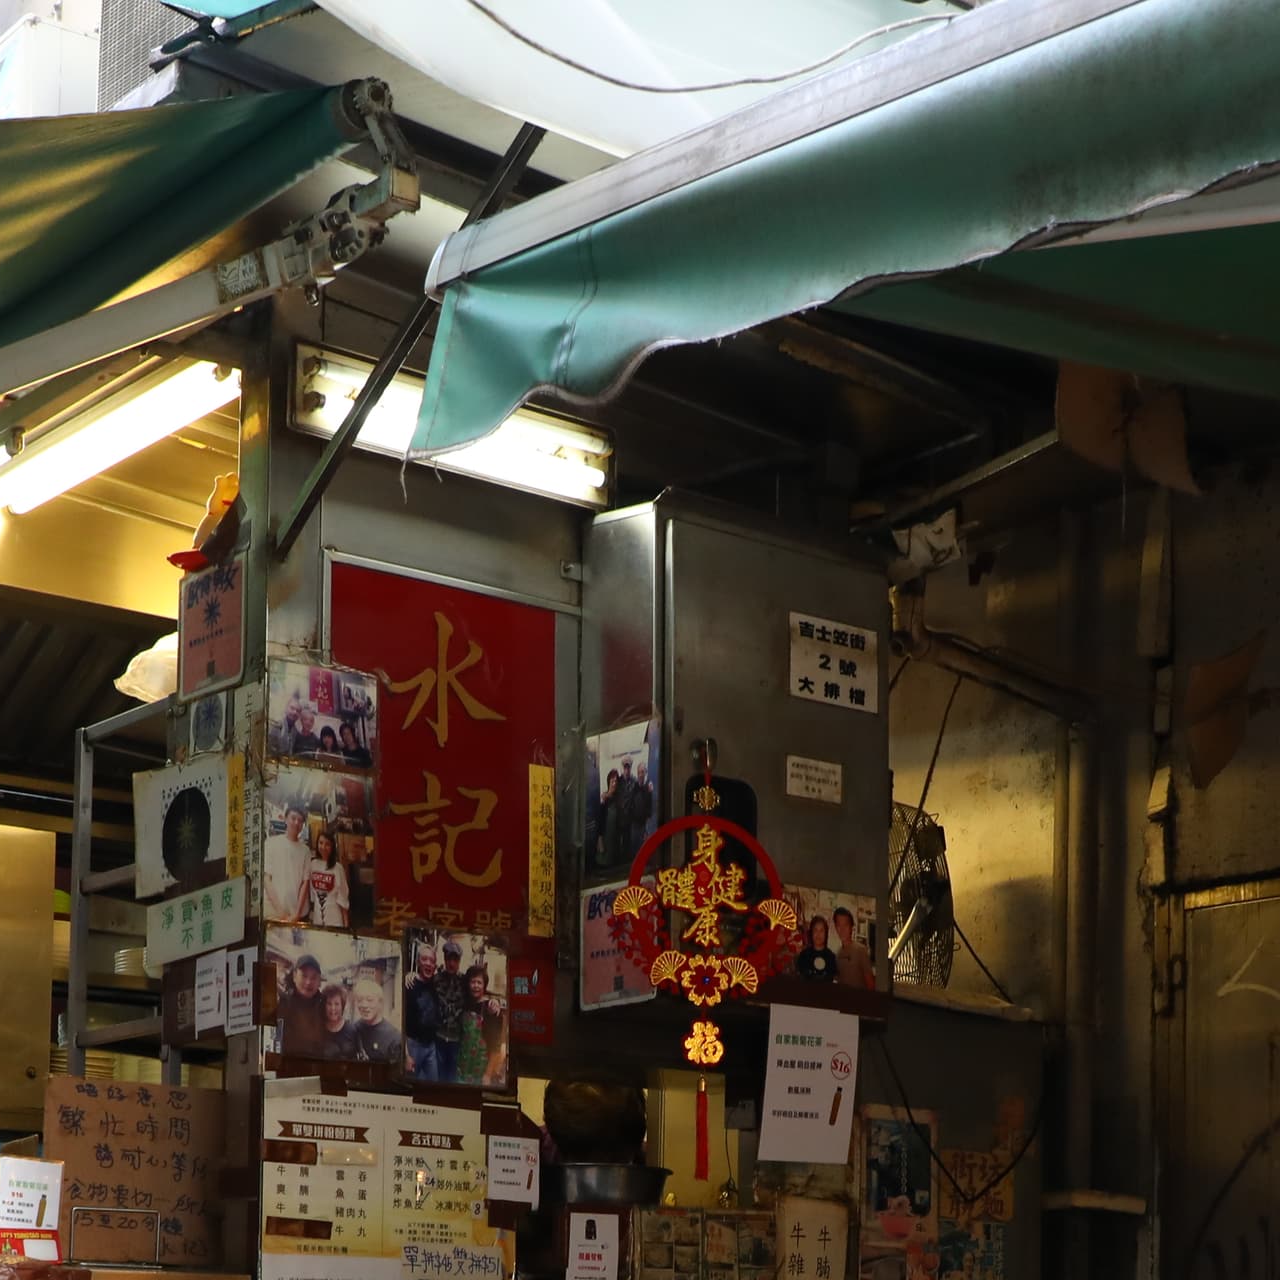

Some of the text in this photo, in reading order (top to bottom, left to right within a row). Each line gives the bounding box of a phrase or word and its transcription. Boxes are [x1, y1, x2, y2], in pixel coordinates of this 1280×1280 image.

[798, 621, 866, 651] 吉士笠街
[798, 676, 866, 706] 大排檔
[387, 610, 507, 888] 水記
[539, 780, 554, 918] 只接受港幣現金
[684, 1020, 725, 1064] 福
[831, 1058, 851, 1074] $16
[393, 1169, 424, 1182] 淨河
[474, 1202, 481, 1215] 8
